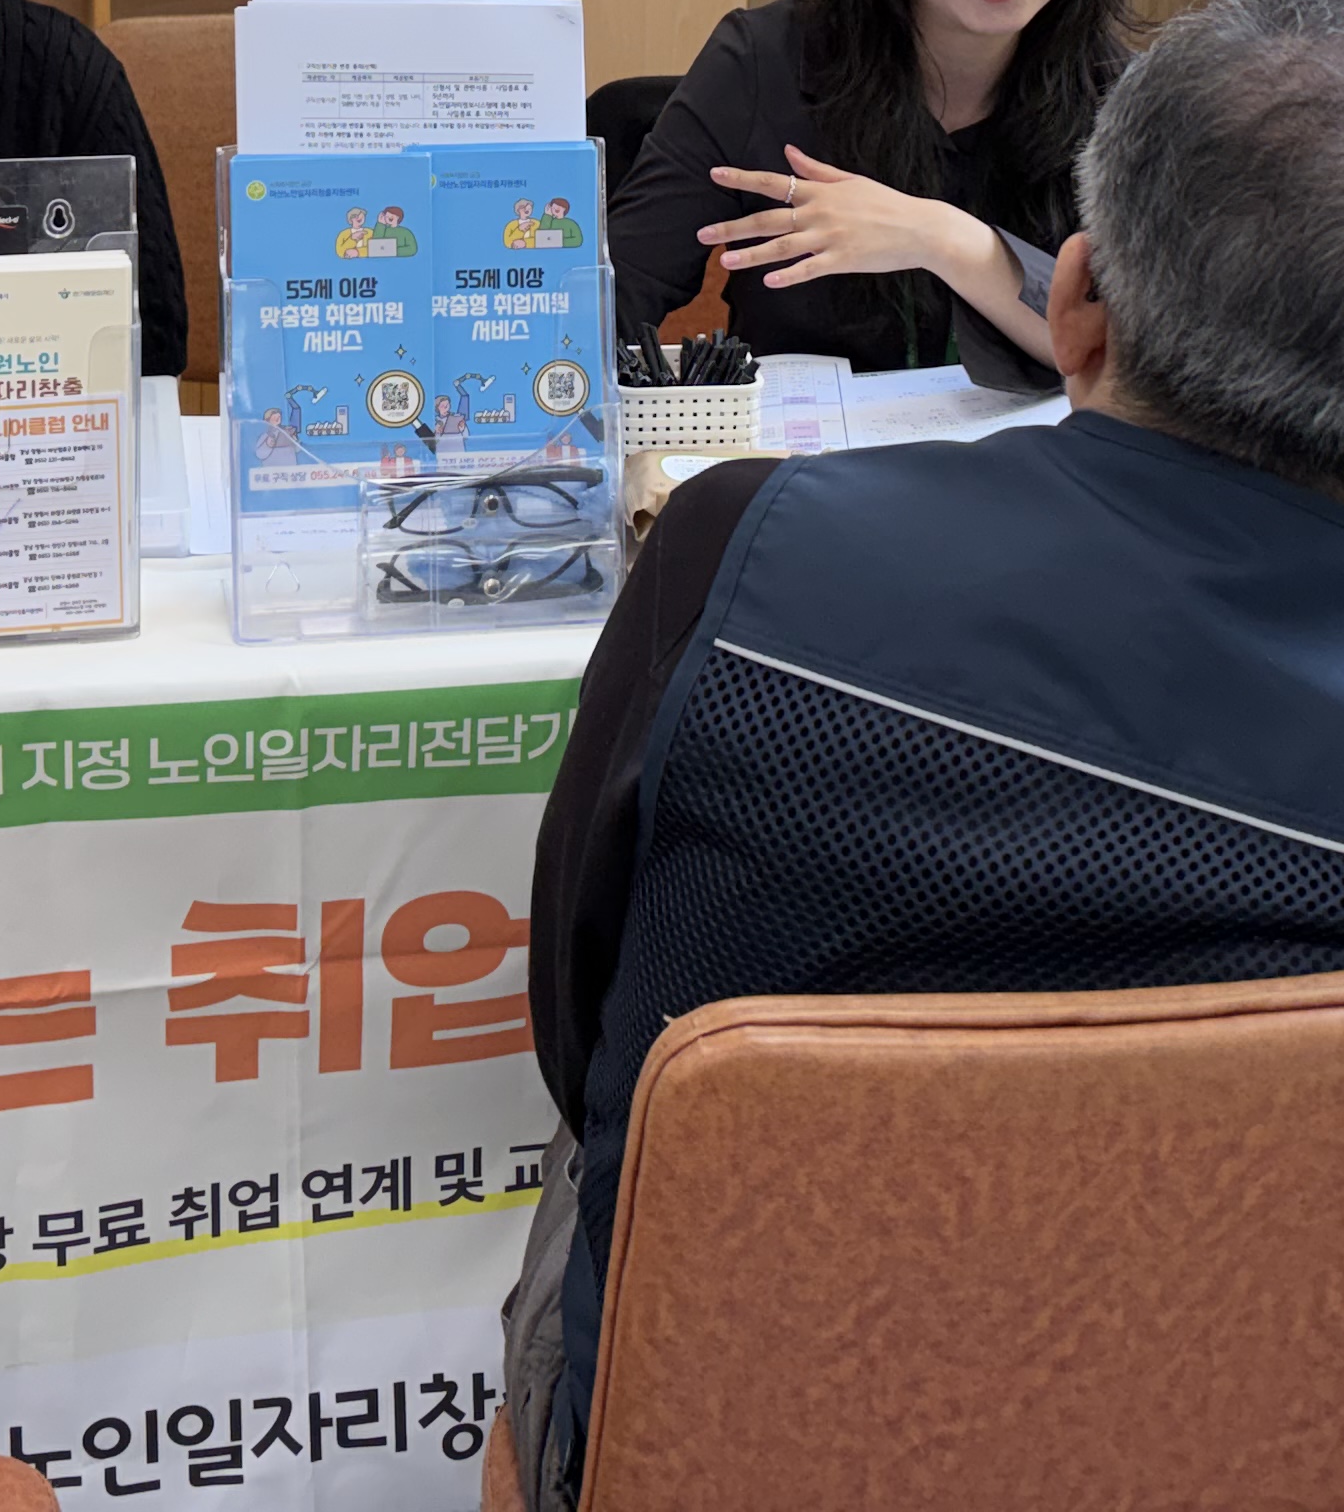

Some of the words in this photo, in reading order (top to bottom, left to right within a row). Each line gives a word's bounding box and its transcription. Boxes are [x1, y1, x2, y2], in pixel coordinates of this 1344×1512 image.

[286, 278, 333, 300] 55세
[340, 277, 378, 298] 이상
[455, 268, 500, 289] 55세
[507, 267, 544, 289] 이상
[260, 304, 320, 328] 맞춤형
[326, 302, 404, 326] 취업지원
[432, 293, 488, 317] 맞춤형
[493, 291, 569, 315] 취업지원
[303, 330, 363, 353] 서비스
[471, 319, 530, 343] 서비스
[72, 413, 109, 433] 안내
[21, 736, 132, 792] 지정
[148, 707, 577, 787] 노인일자리전담기
[165, 889, 534, 1083] 취업
[32, 1197, 150, 1267] 무료
[168, 1173, 280, 1241] 취업
[301, 1156, 413, 1223] 연계
[434, 1146, 485, 1208] 및
